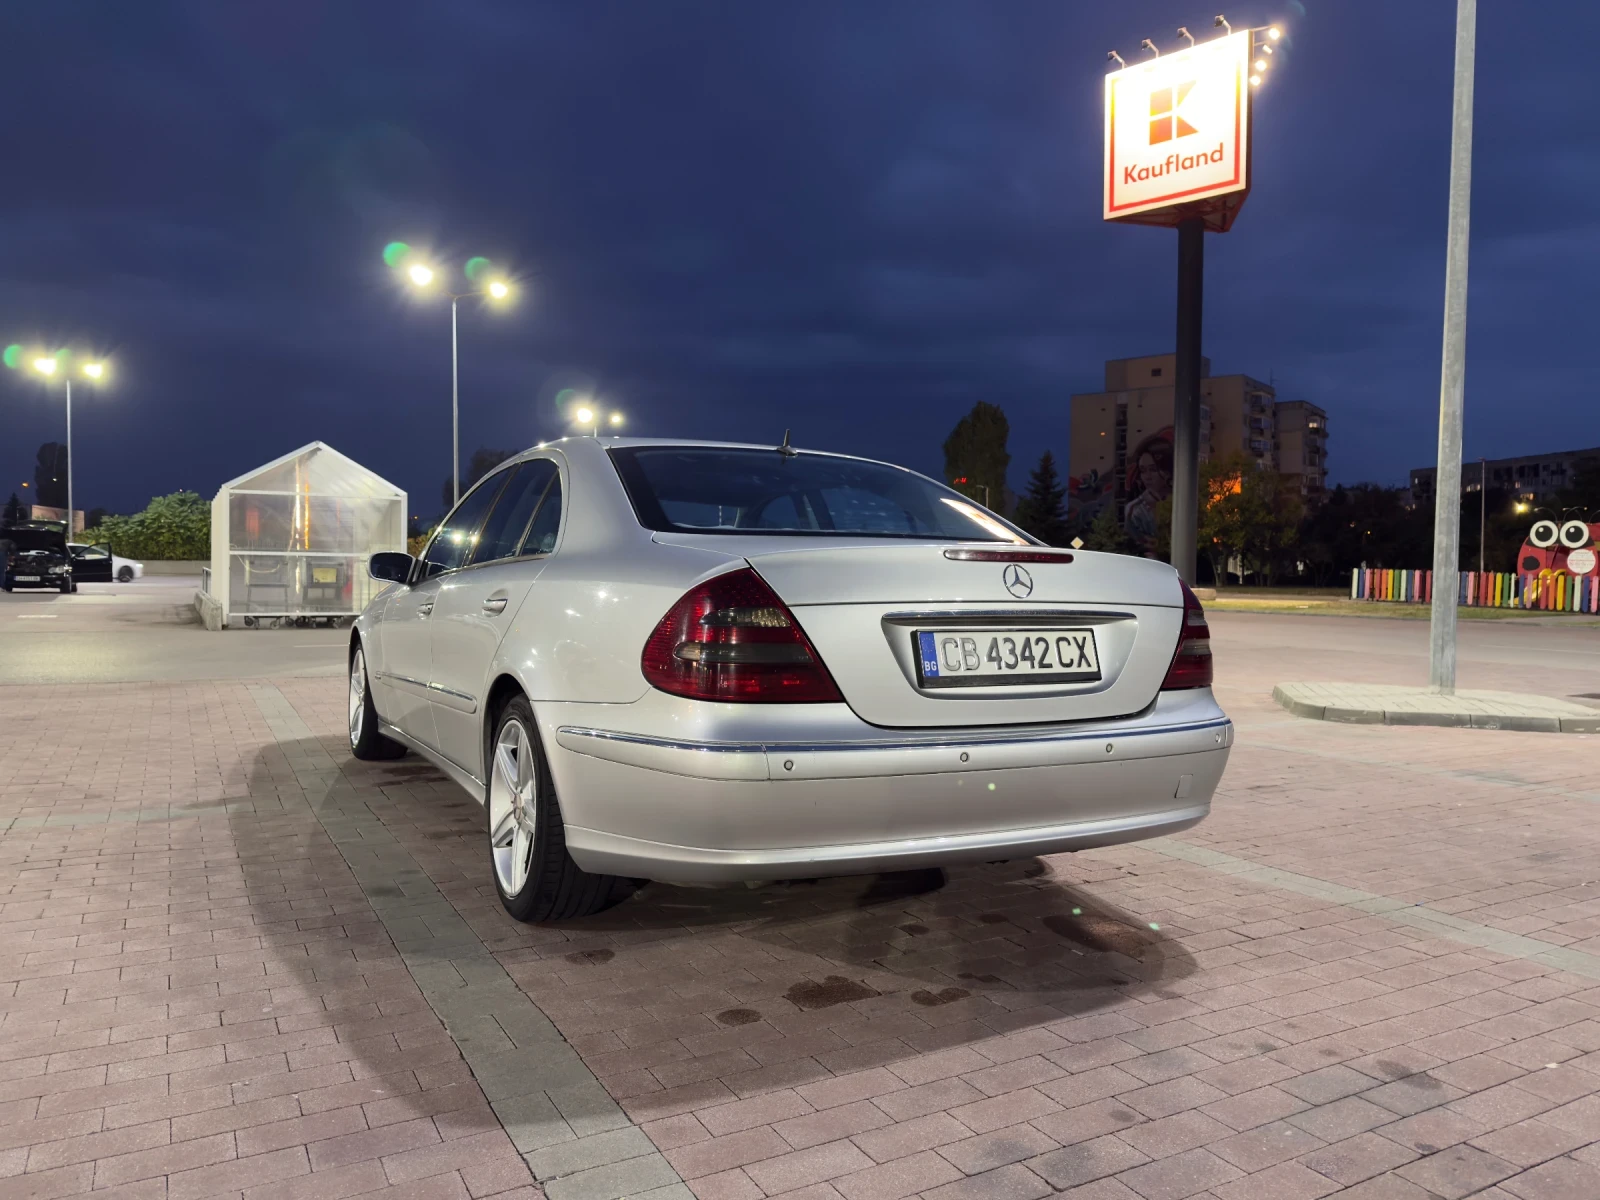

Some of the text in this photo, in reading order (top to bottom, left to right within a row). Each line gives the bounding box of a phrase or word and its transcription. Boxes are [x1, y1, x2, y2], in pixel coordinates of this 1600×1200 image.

[1149, 79, 1199, 146] K
[1123, 142, 1224, 185] Kaufland
[924, 661, 937, 671] BG
